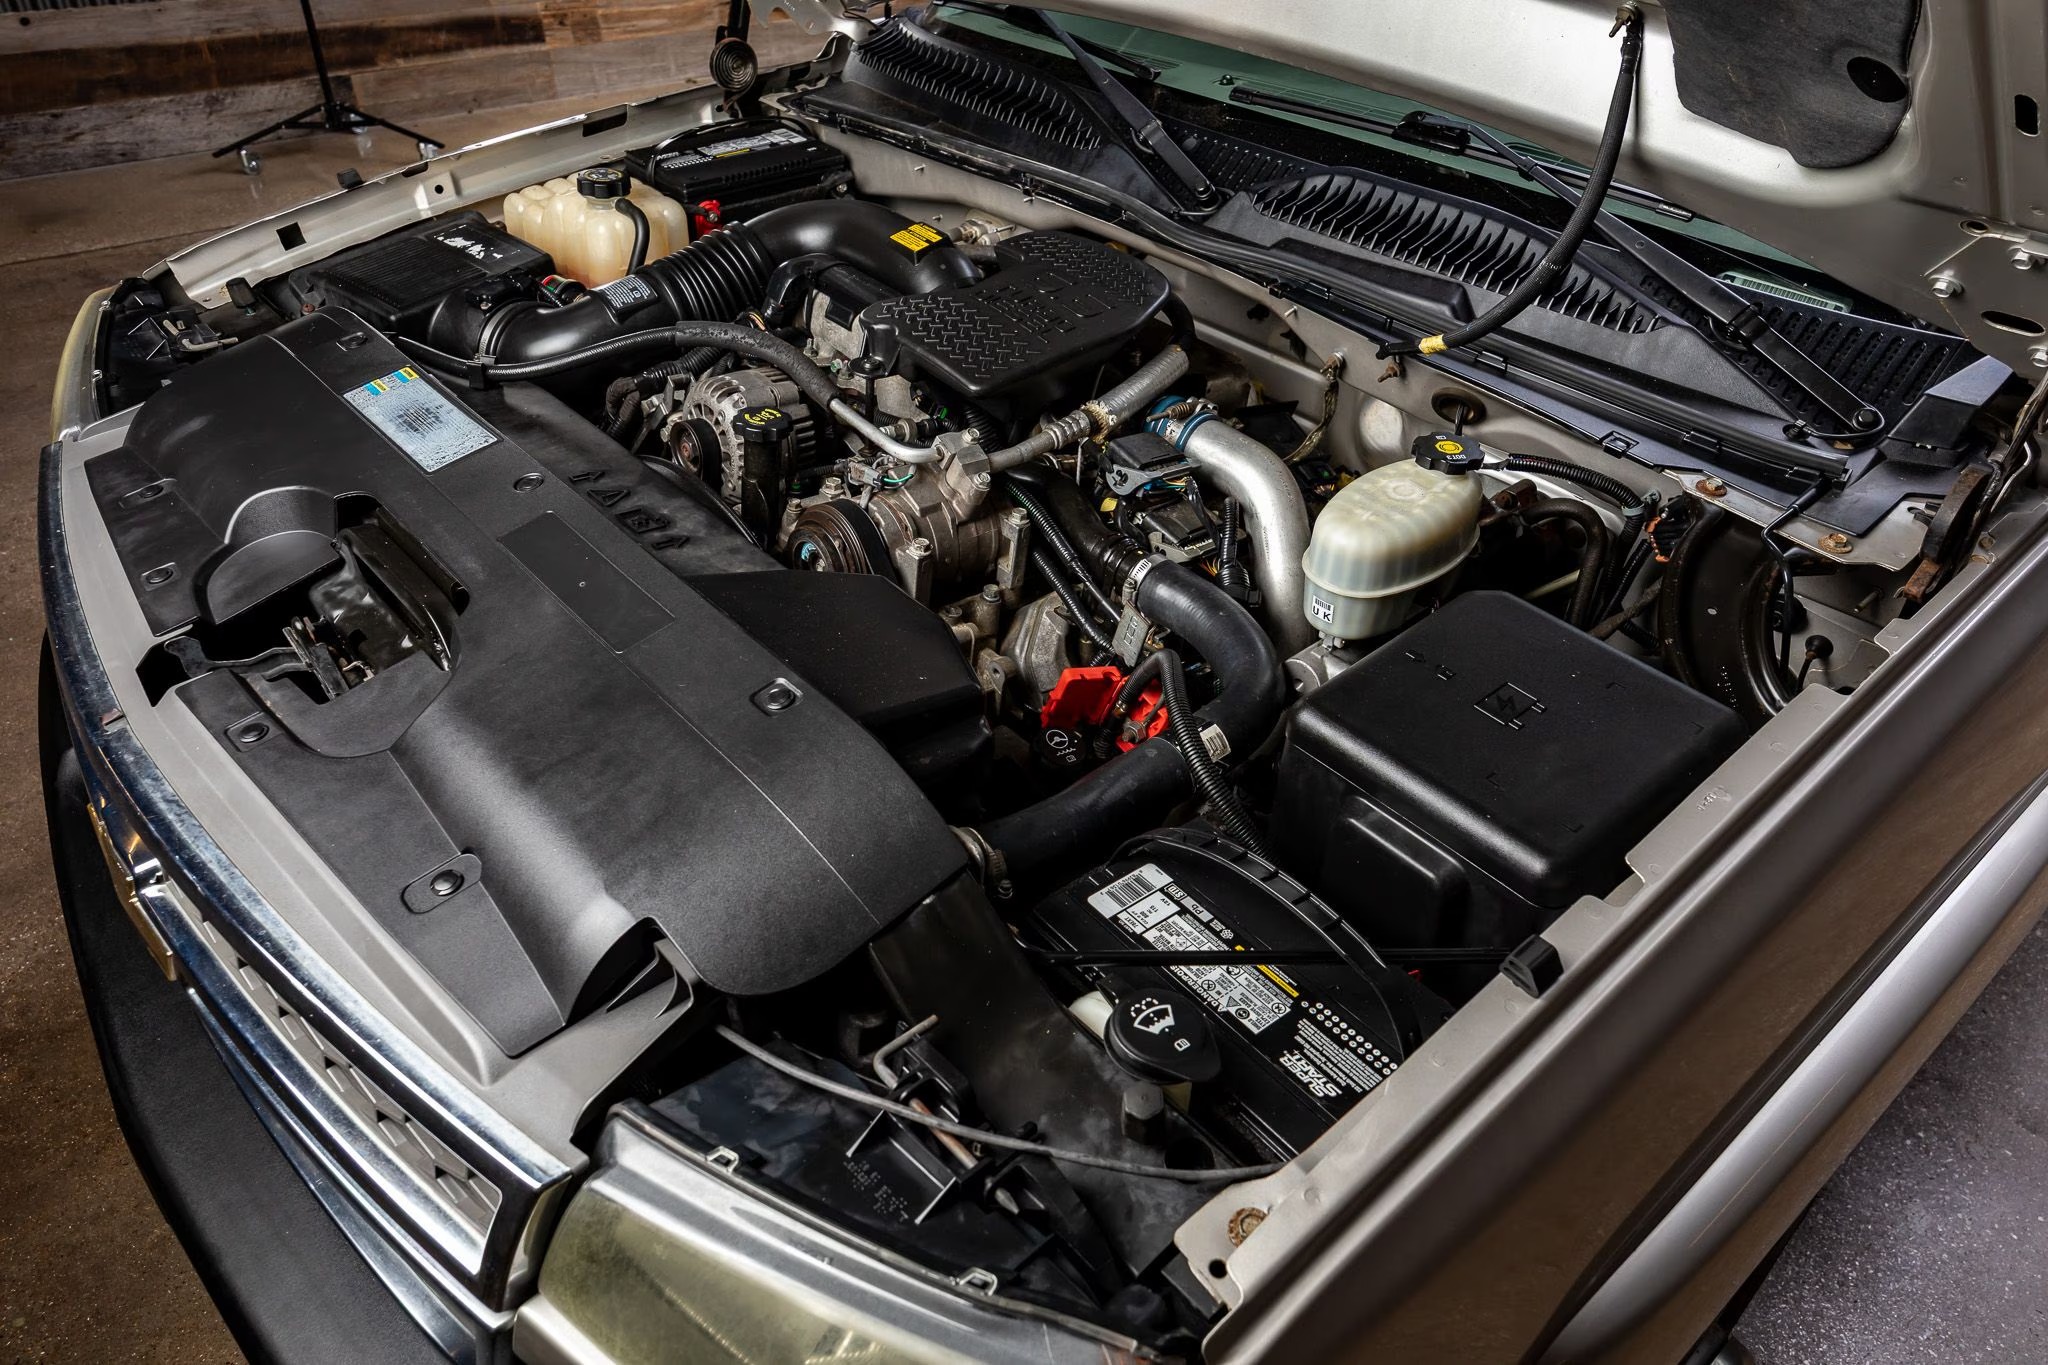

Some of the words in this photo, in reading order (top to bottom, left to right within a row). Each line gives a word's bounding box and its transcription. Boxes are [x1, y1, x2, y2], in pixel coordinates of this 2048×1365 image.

[1167, 885, 1182, 897] STD
[1189, 903, 1203, 914] Pb
[1169, 964, 1220, 1006] DANGER/POIS
[1279, 1055, 1331, 1097] SUPER
[1288, 1053, 1343, 1097] START
